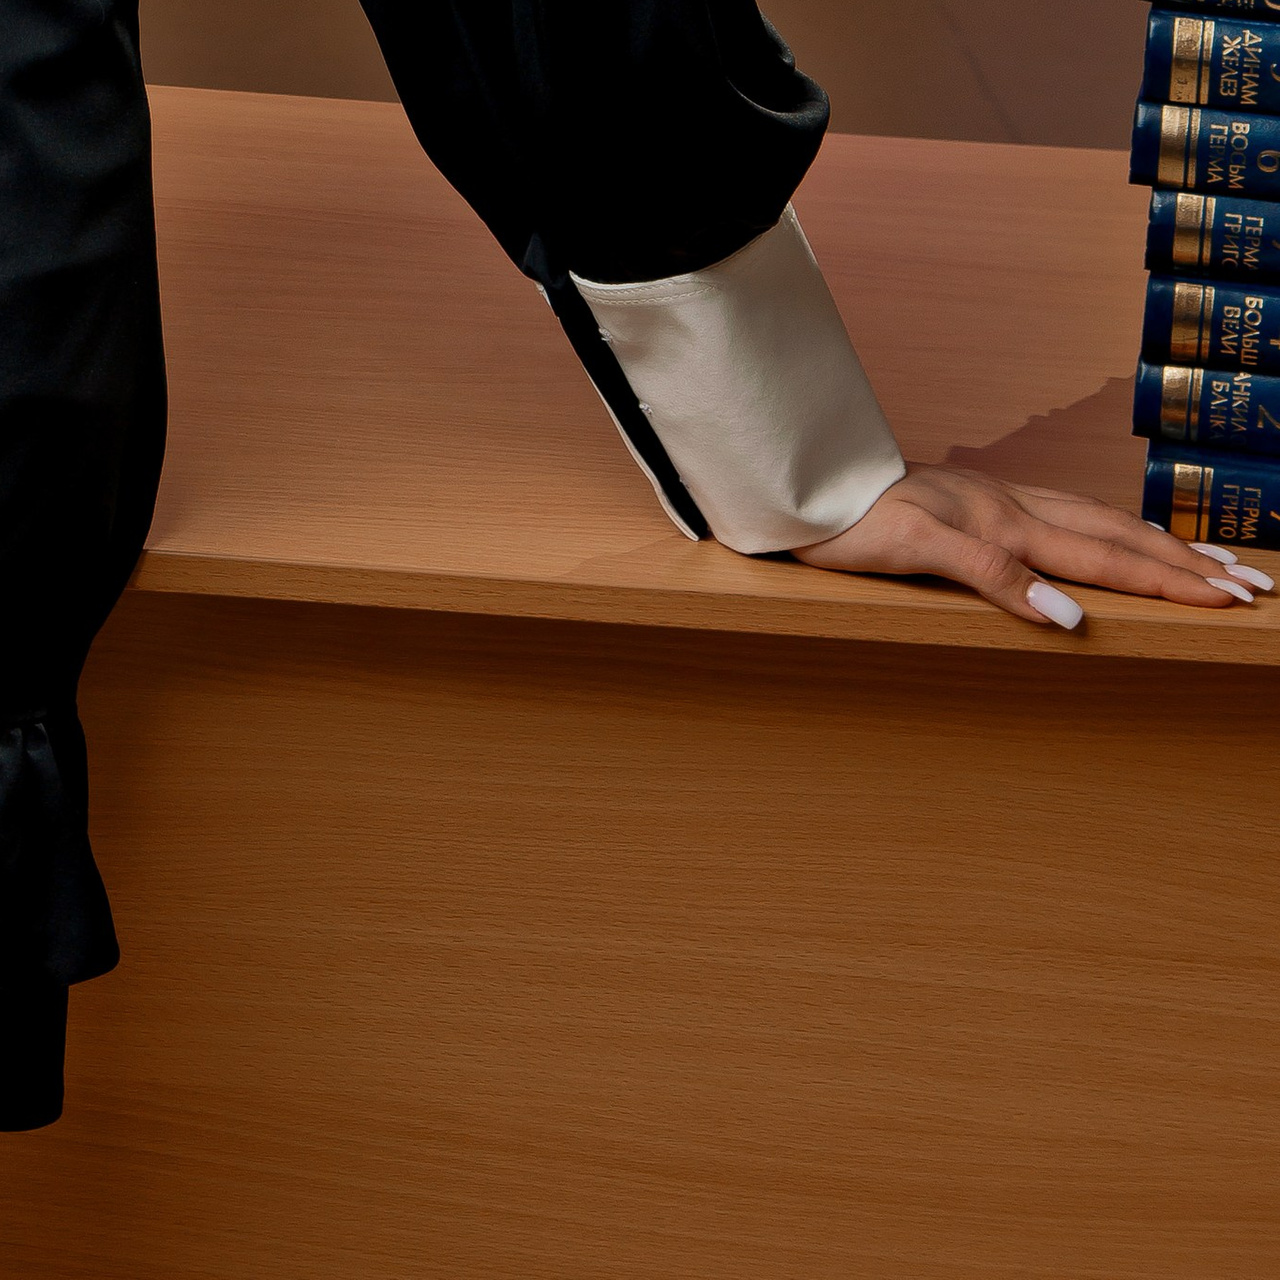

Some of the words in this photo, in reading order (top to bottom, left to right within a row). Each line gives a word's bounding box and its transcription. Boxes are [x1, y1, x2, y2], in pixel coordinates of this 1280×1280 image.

[1219, 34, 1242, 96] ЖЕЛЕЗ
[1240, 29, 1263, 105] ДИНАМ
[1206, 123, 1229, 184] ГЕРМА
[1227, 121, 1251, 189] ВОСЬМ
[1220, 305, 1242, 355] ВЕЛИ
[1240, 295, 1264, 366] БОЛЬШ
[1208, 380, 1231, 440] БАНКА
[1219, 483, 1240, 539] ГРИГО
[1240, 486, 1262, 540] ГЕРМА
